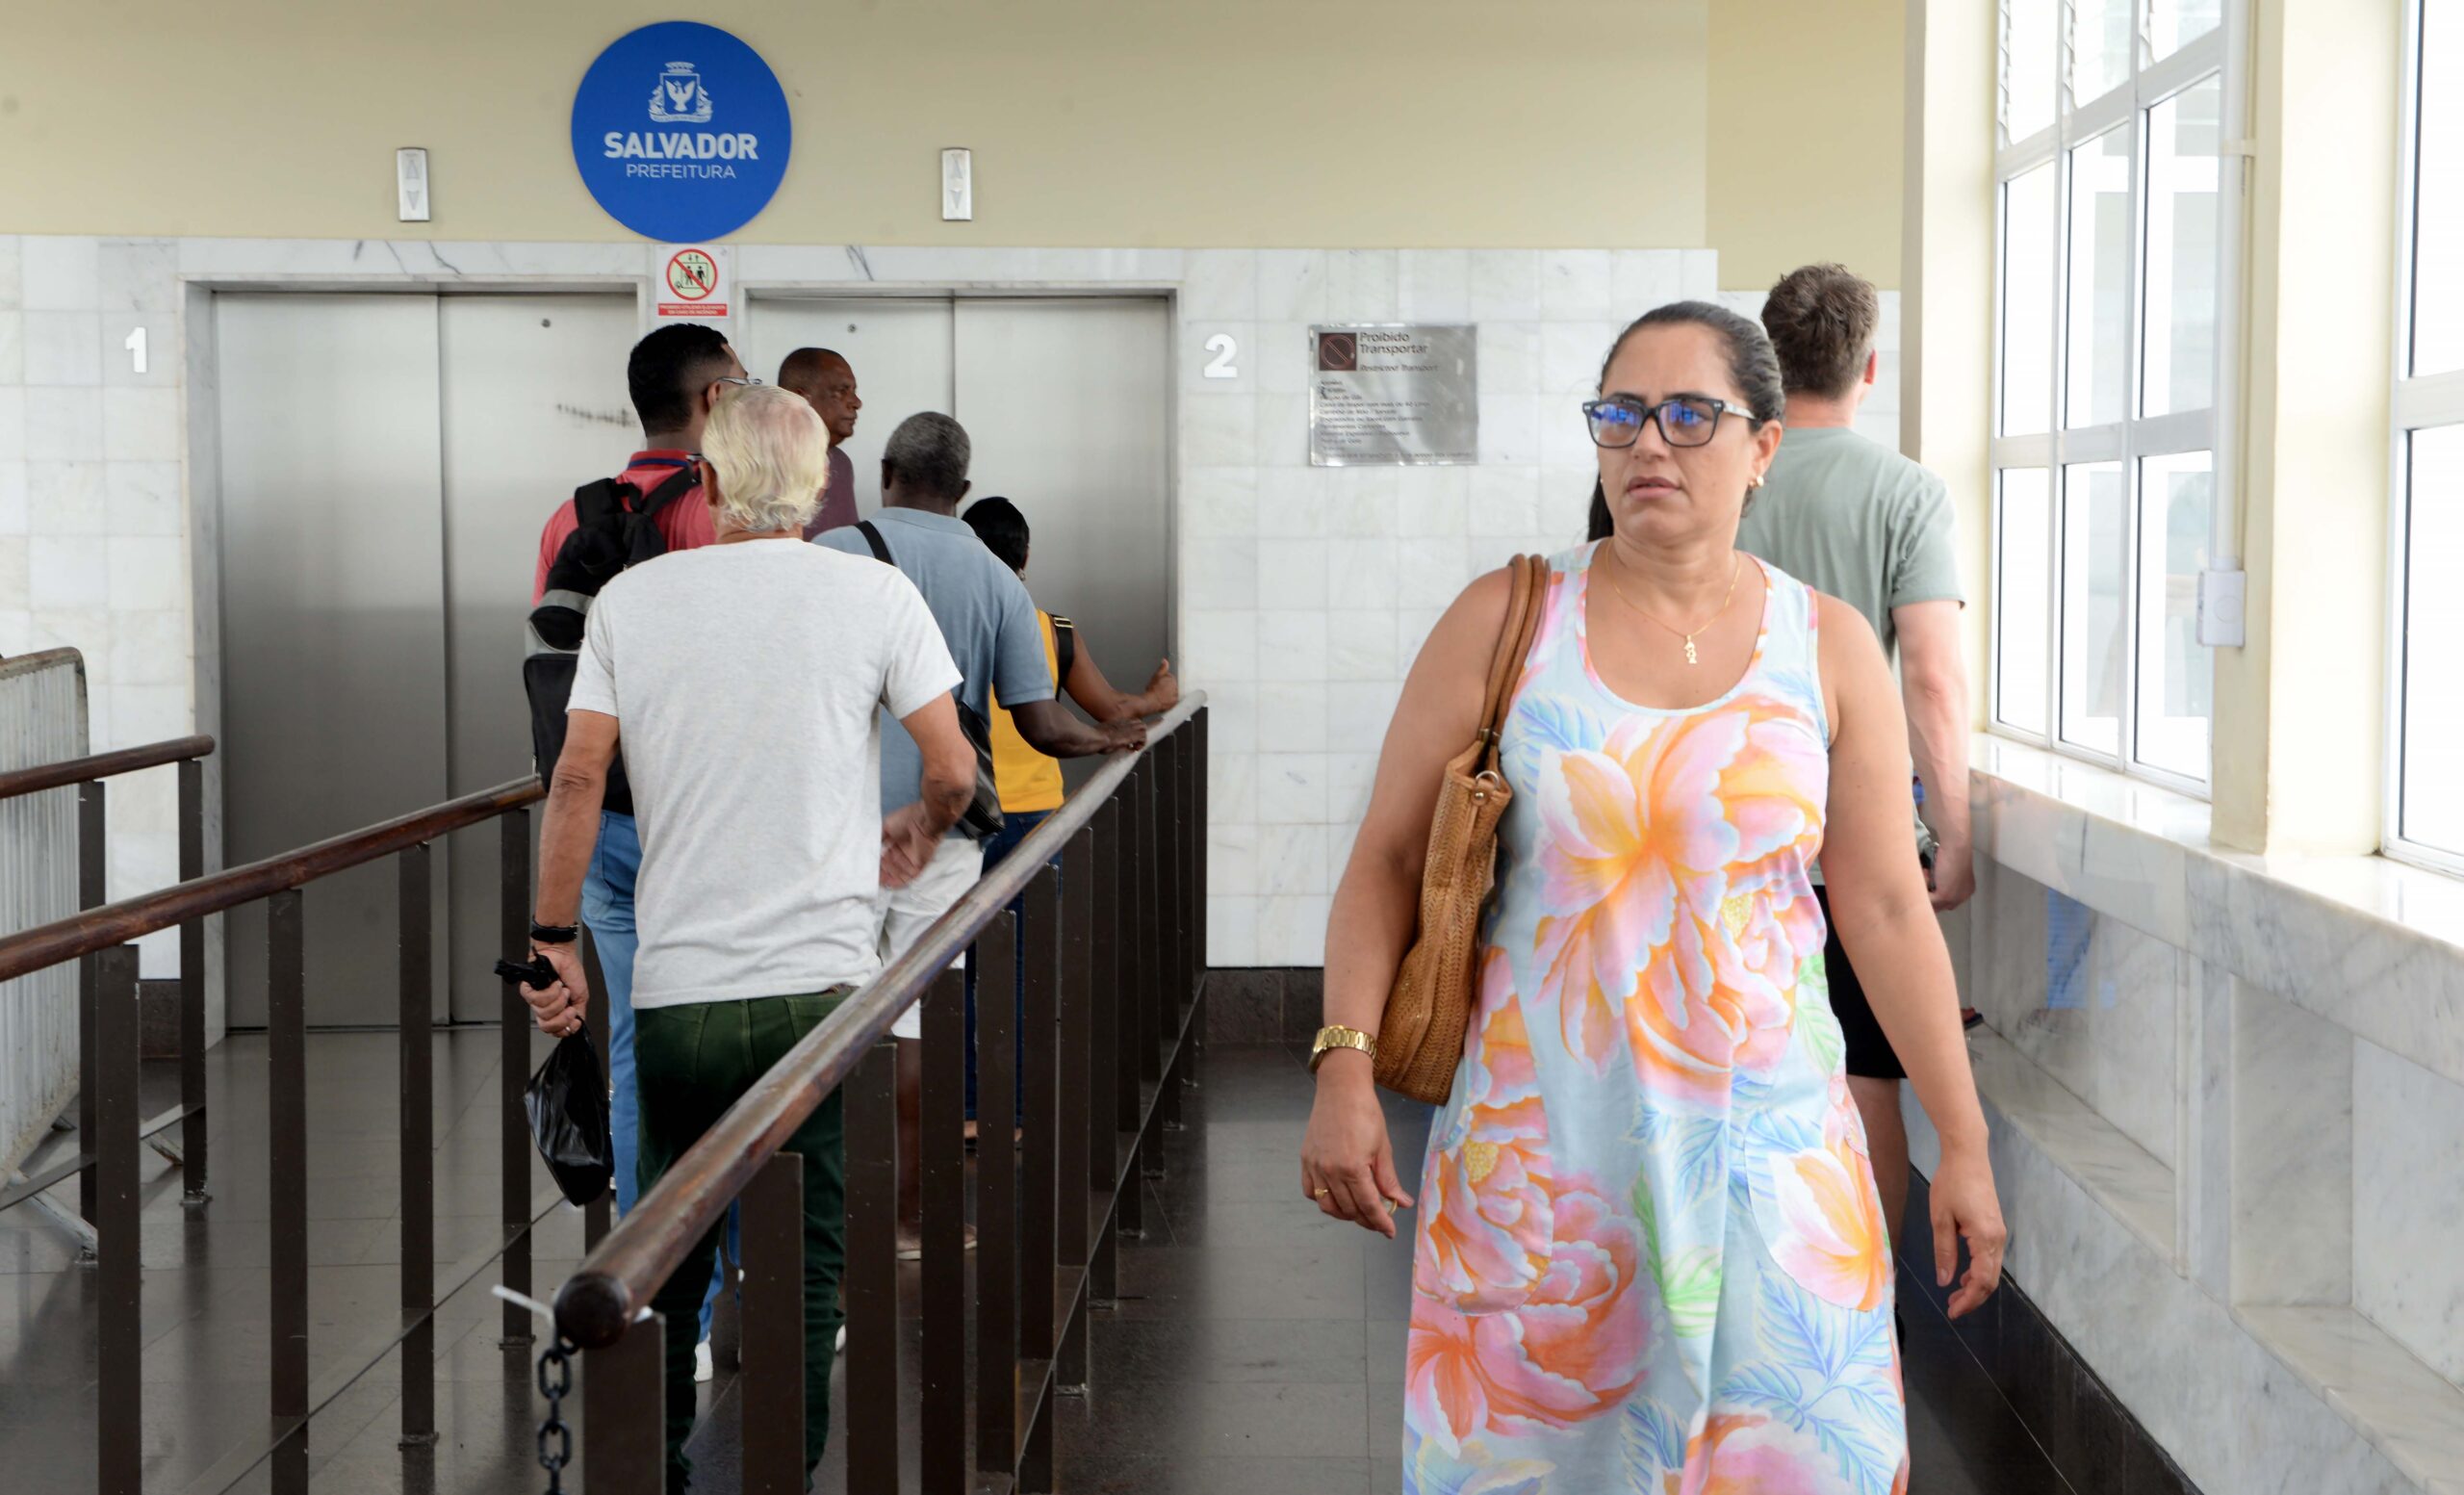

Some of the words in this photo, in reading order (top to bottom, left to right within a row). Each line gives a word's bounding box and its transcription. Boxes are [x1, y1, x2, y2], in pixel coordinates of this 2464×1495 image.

[603, 131, 759, 160] SALVADOR
[626, 163, 737, 179] PREFEITURA
[1359, 331, 1410, 343] Proibido
[125, 326, 147, 374] 1
[1203, 332, 1238, 378] 2
[1359, 344, 1428, 356] Transportar
